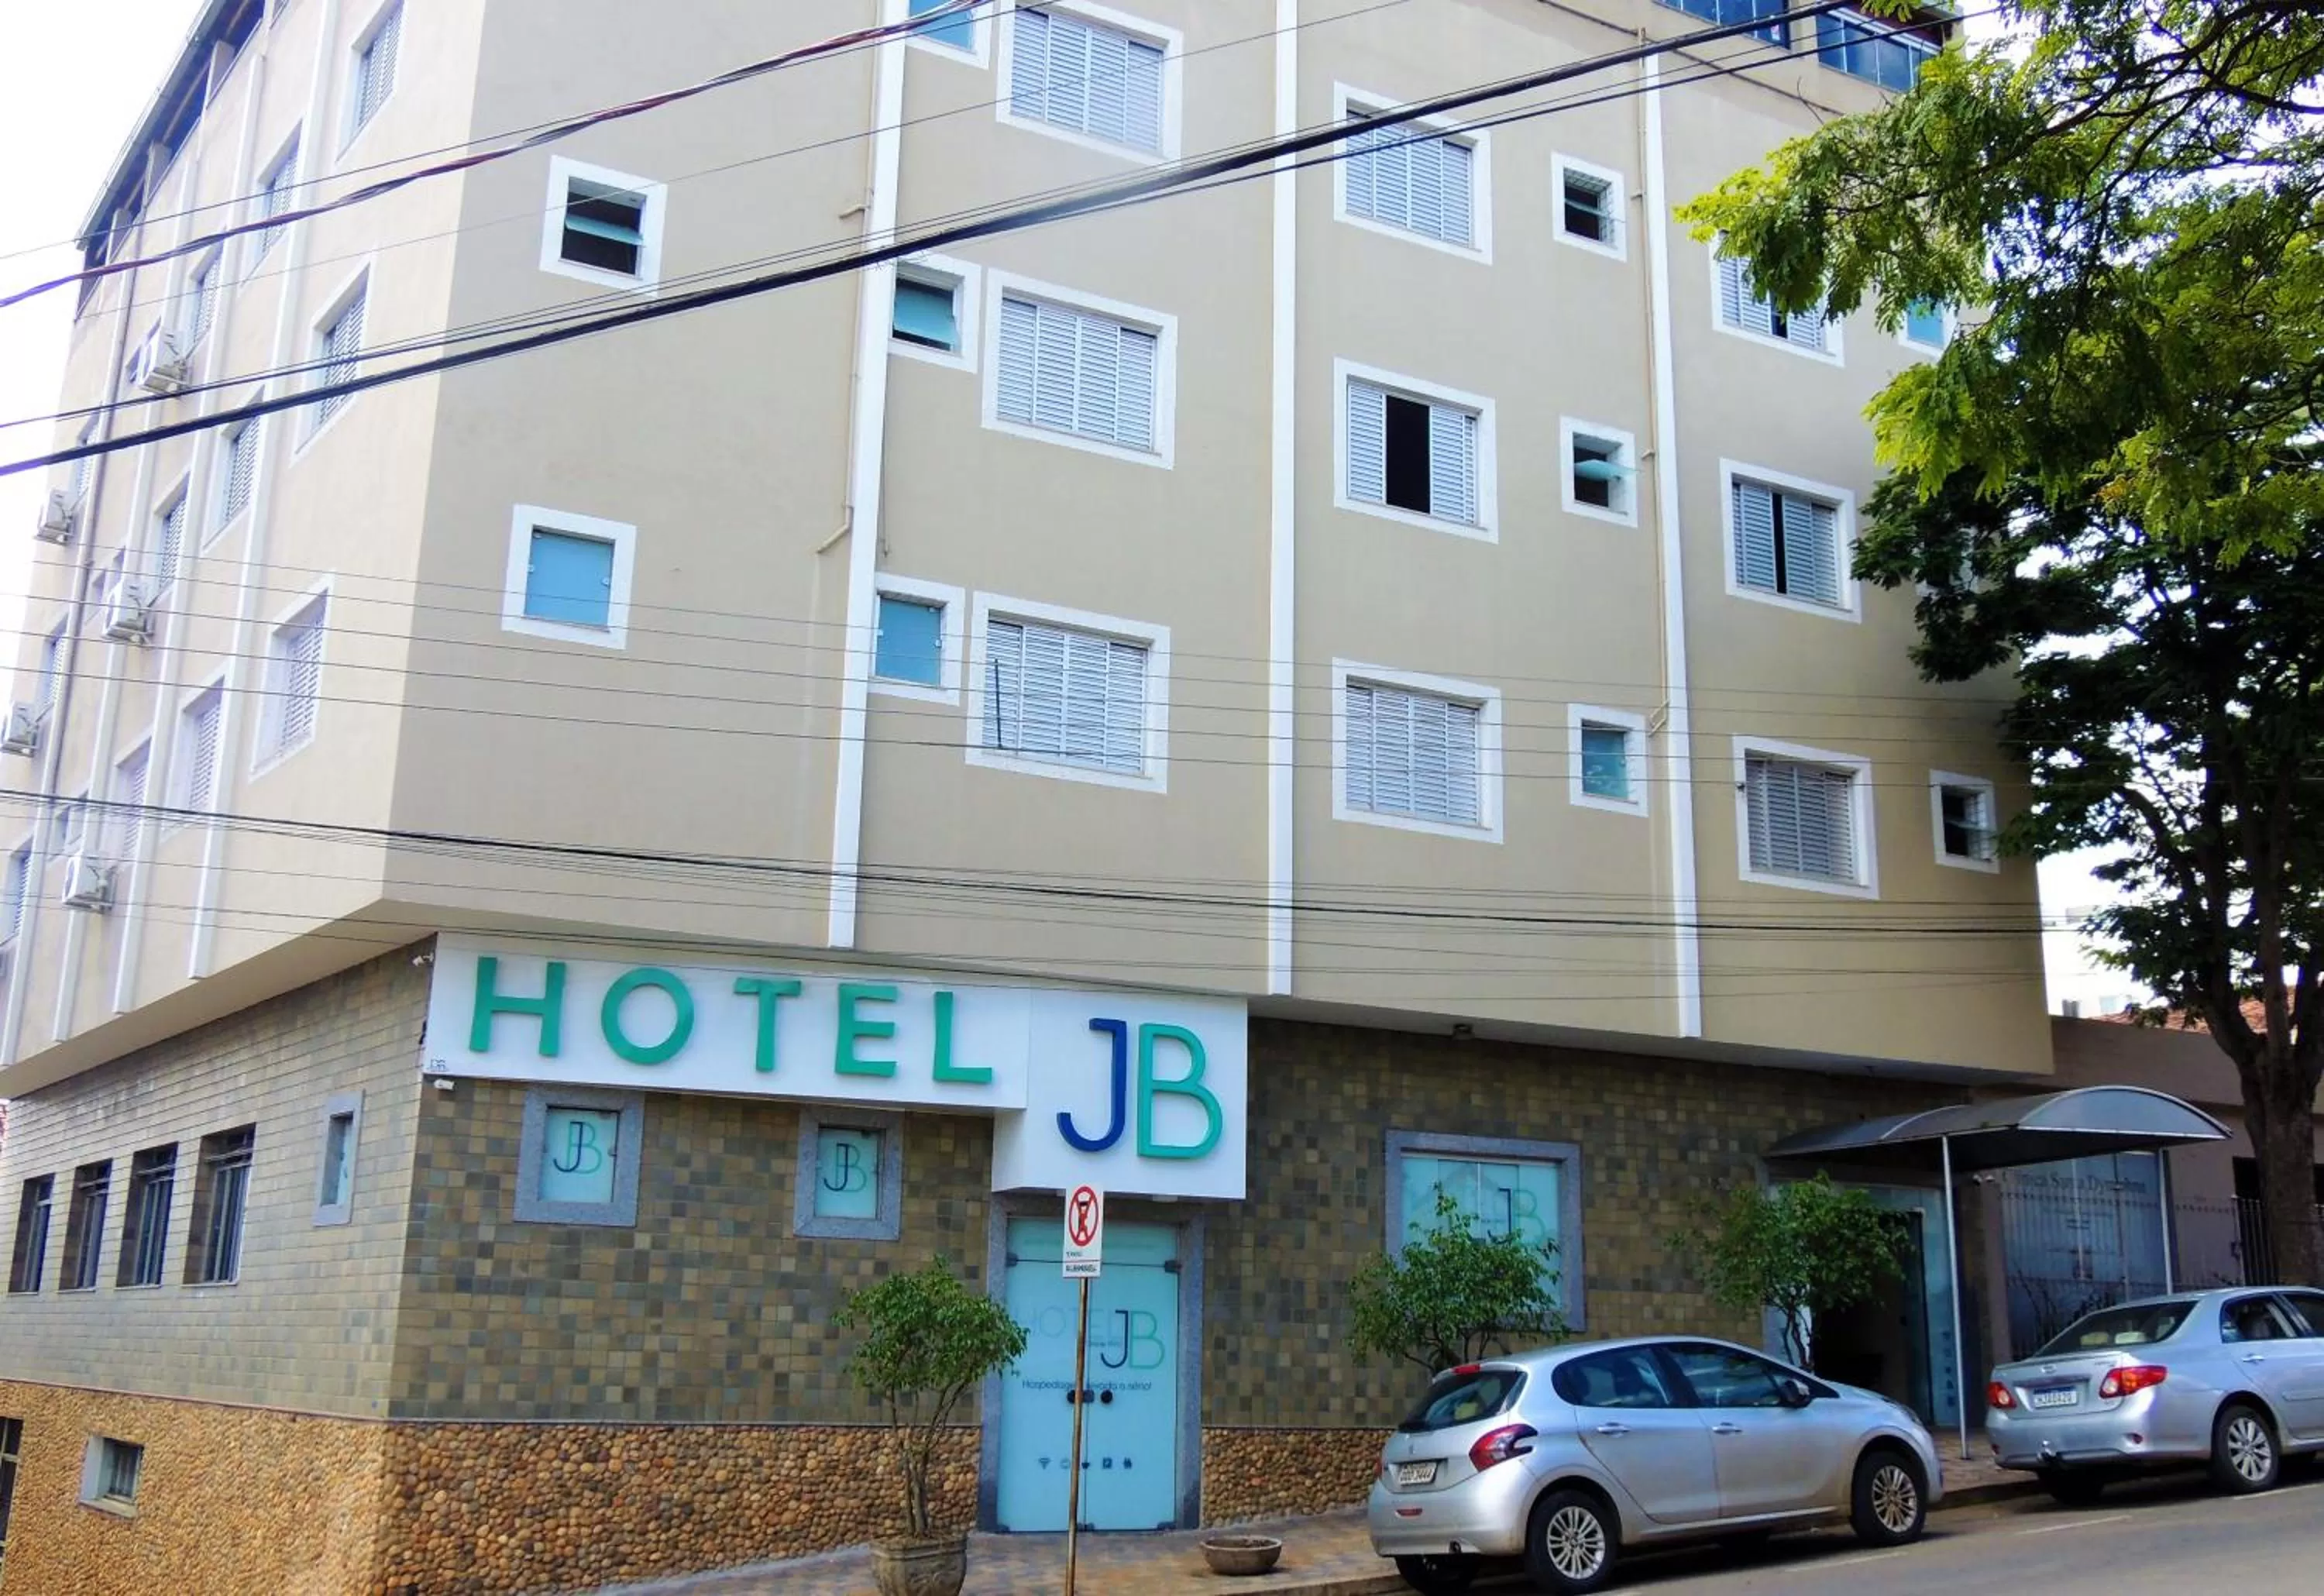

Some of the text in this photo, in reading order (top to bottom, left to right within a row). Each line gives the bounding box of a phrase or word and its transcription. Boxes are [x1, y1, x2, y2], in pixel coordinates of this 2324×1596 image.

[469, 955, 1223, 1160] HOTEL JB
[552, 1120, 603, 1175] JB
[823, 1143, 868, 1192] JB
[1487, 1187, 1546, 1246] JB
[1101, 1309, 1165, 1370] JB
[1022, 1379, 1078, 1391] Hospedage
